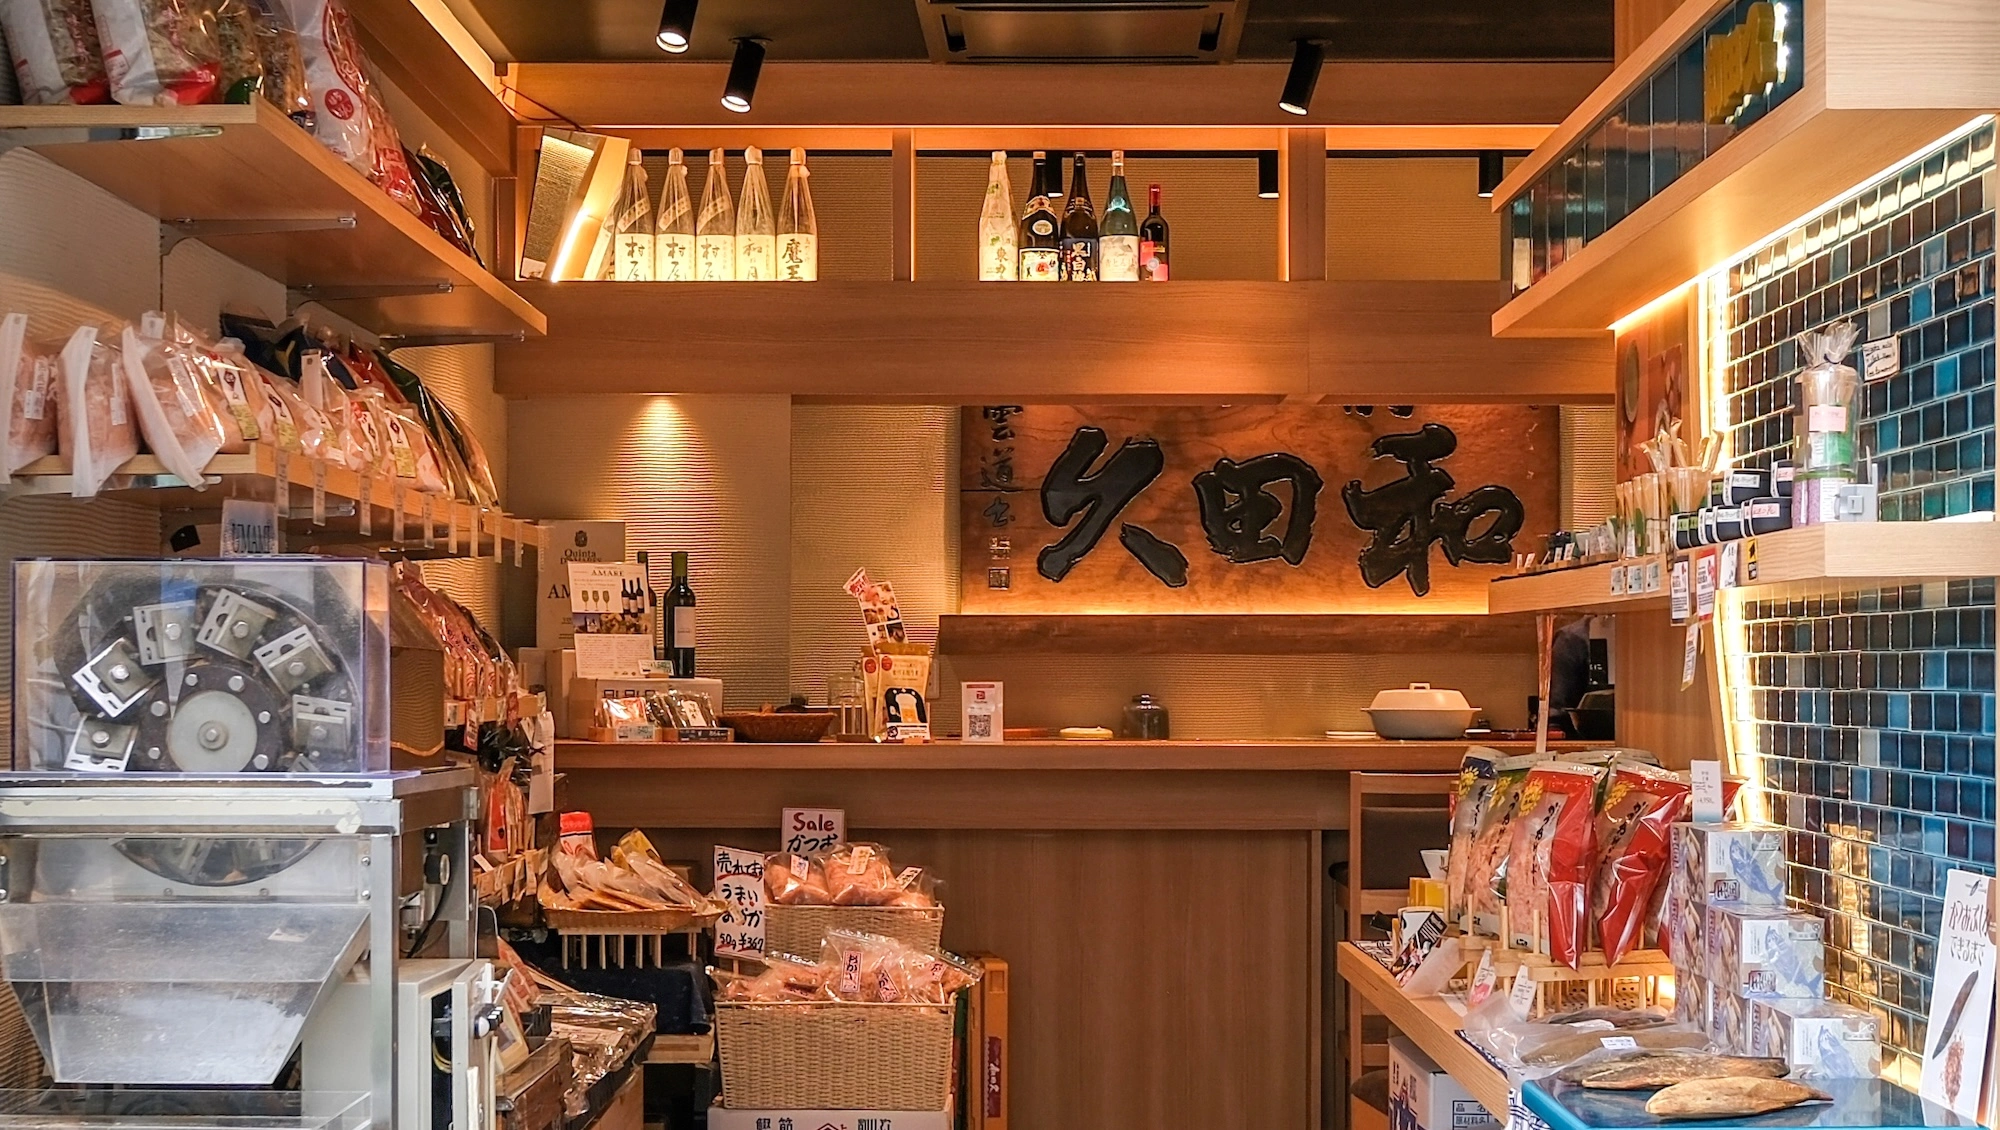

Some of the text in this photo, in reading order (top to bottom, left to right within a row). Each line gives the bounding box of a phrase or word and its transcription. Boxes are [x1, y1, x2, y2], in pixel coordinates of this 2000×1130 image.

[782, 237, 804, 281] 魔王
[564, 549, 597, 559] Quinta
[793, 812, 835, 832] Sale
[786, 833, 839, 853] かつお
[721, 884, 758, 903] うまい
[1950, 936, 1985, 966] できるまで
